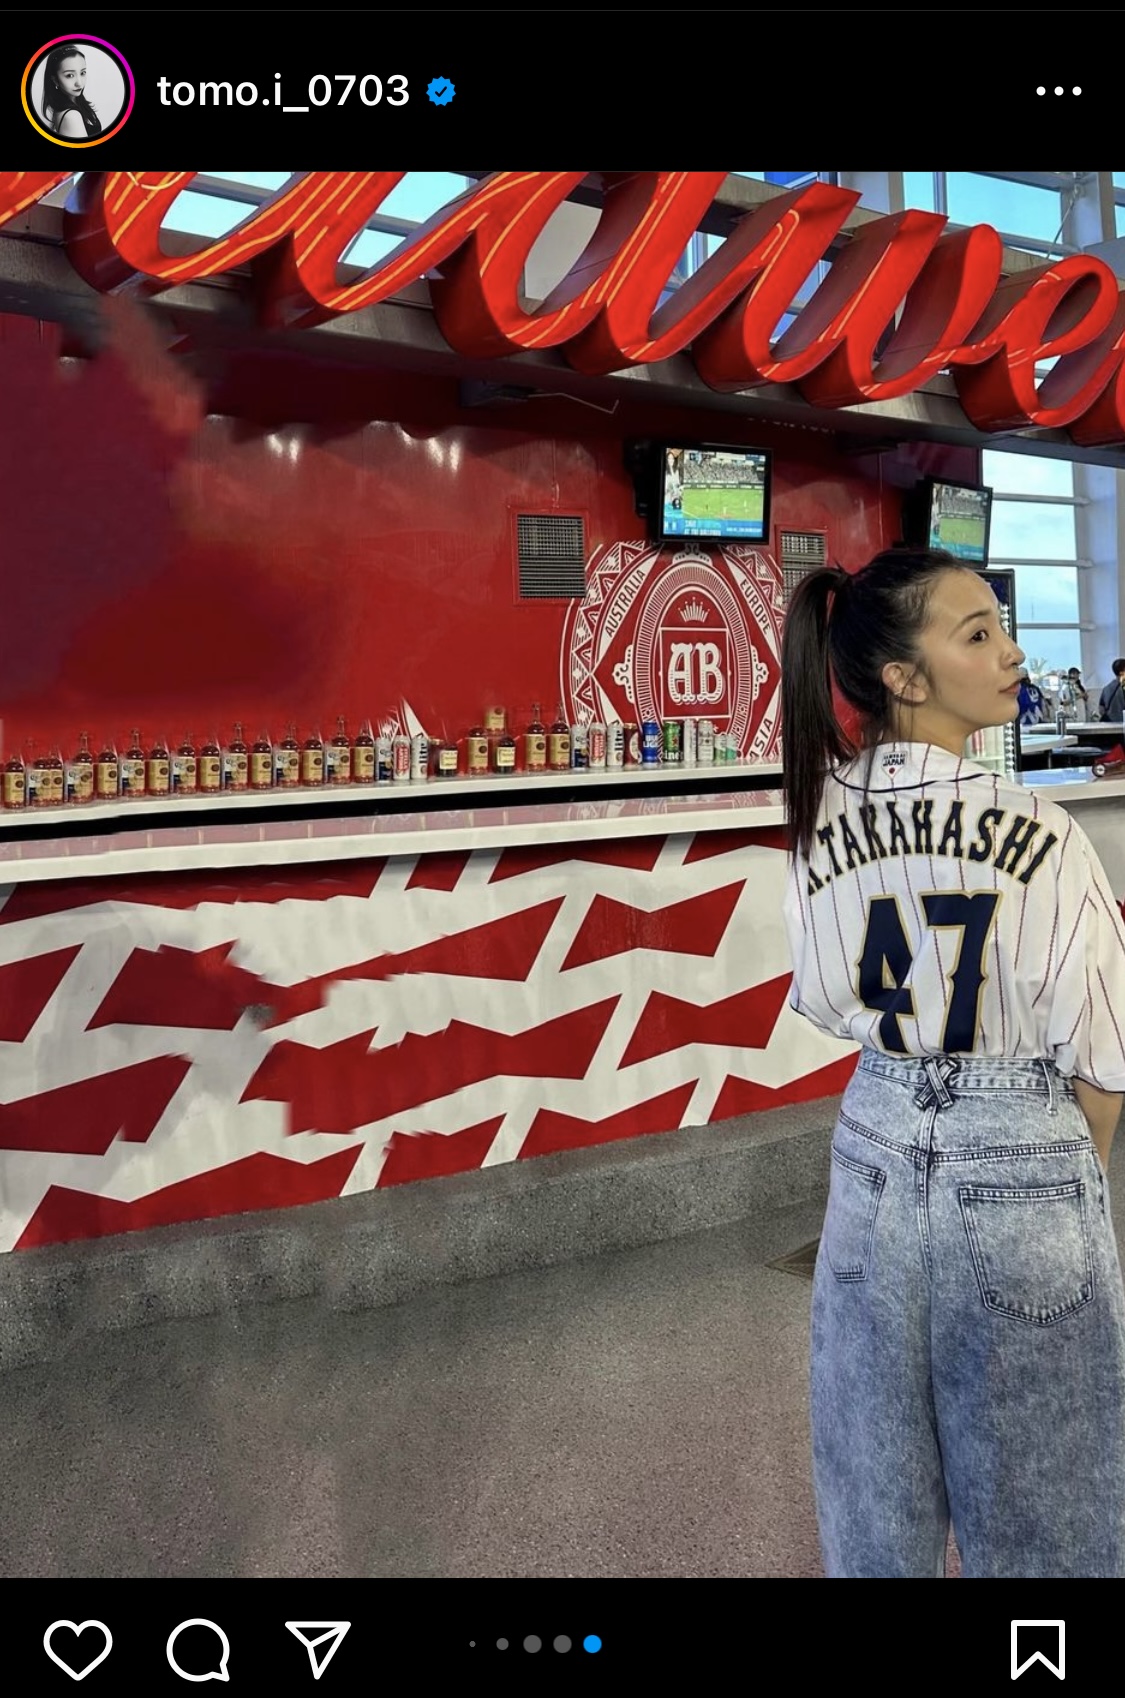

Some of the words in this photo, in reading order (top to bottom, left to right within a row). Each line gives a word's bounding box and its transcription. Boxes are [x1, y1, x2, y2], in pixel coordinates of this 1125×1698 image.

[605, 568, 648, 638] AUSTRALIA
[739, 579, 772, 635] EUROPE
[667, 641, 726, 706] AB
[882, 758, 905, 767] JAPAN
[856, 889, 1004, 1057] 47
